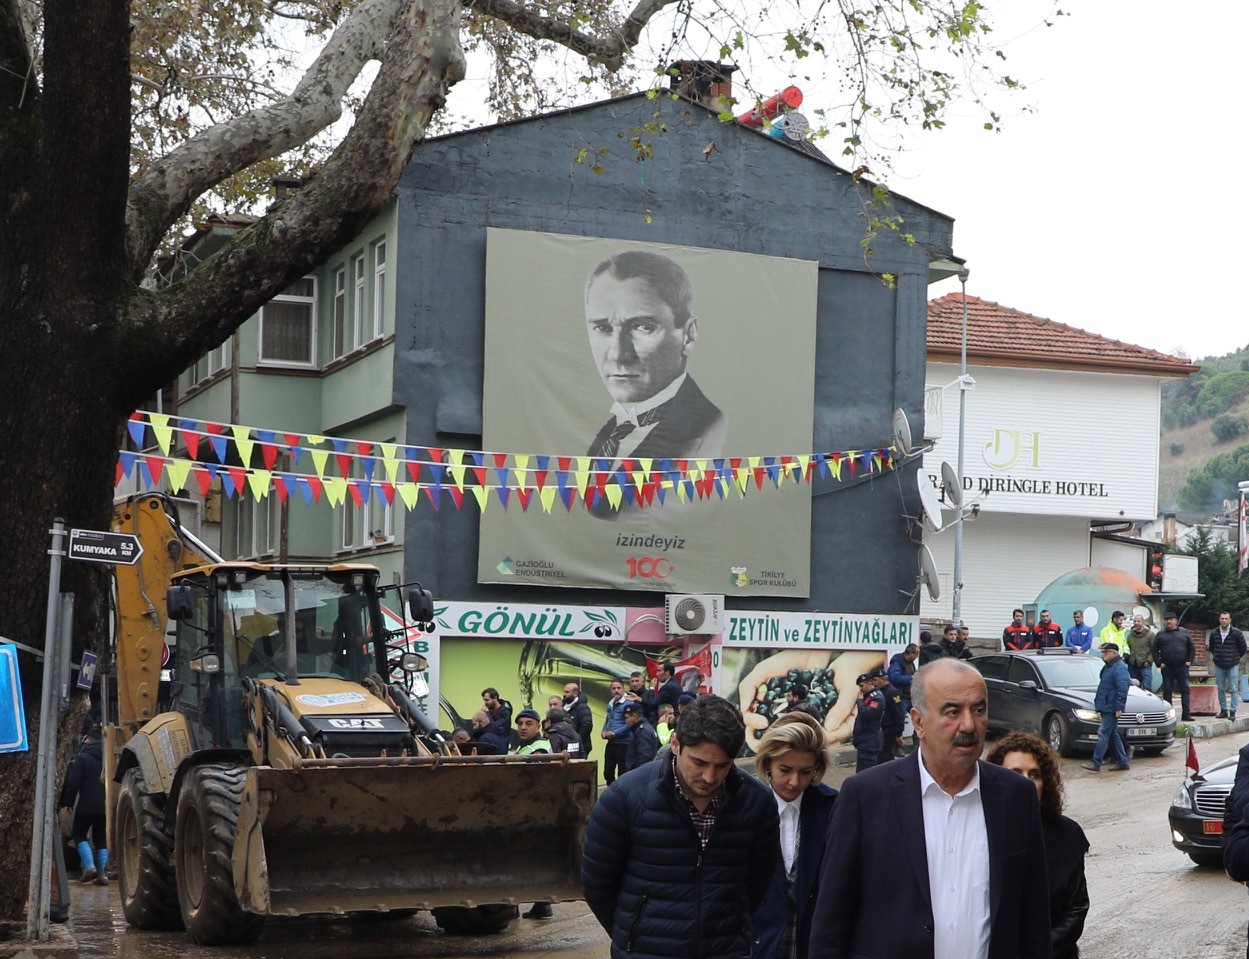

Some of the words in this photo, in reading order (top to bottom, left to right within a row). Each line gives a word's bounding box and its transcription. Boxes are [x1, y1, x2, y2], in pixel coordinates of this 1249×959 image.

[978, 474, 1051, 494] DİRİNGLE
[1055, 481, 1109, 497] HOTEL
[120, 542, 134, 550] 5.3
[616, 533, 686, 552] izindeyiz
[73, 544, 117, 556] KUMYAKA
[515, 560, 554, 570] GAZİOĞLU
[760, 570, 786, 580] TİRİLYE
[749, 578, 768, 586] SPOR
[769, 578, 797, 587] KULÜBÜ
[457, 606, 576, 637] GÖNÜL
[729, 614, 780, 641] ZEYTİN
[784, 628, 799, 642] ve
[804, 617, 913, 644] ZEYTİNYAĞLARI
[328, 718, 385, 729] CAT
[1205, 822, 1215, 832] 16
